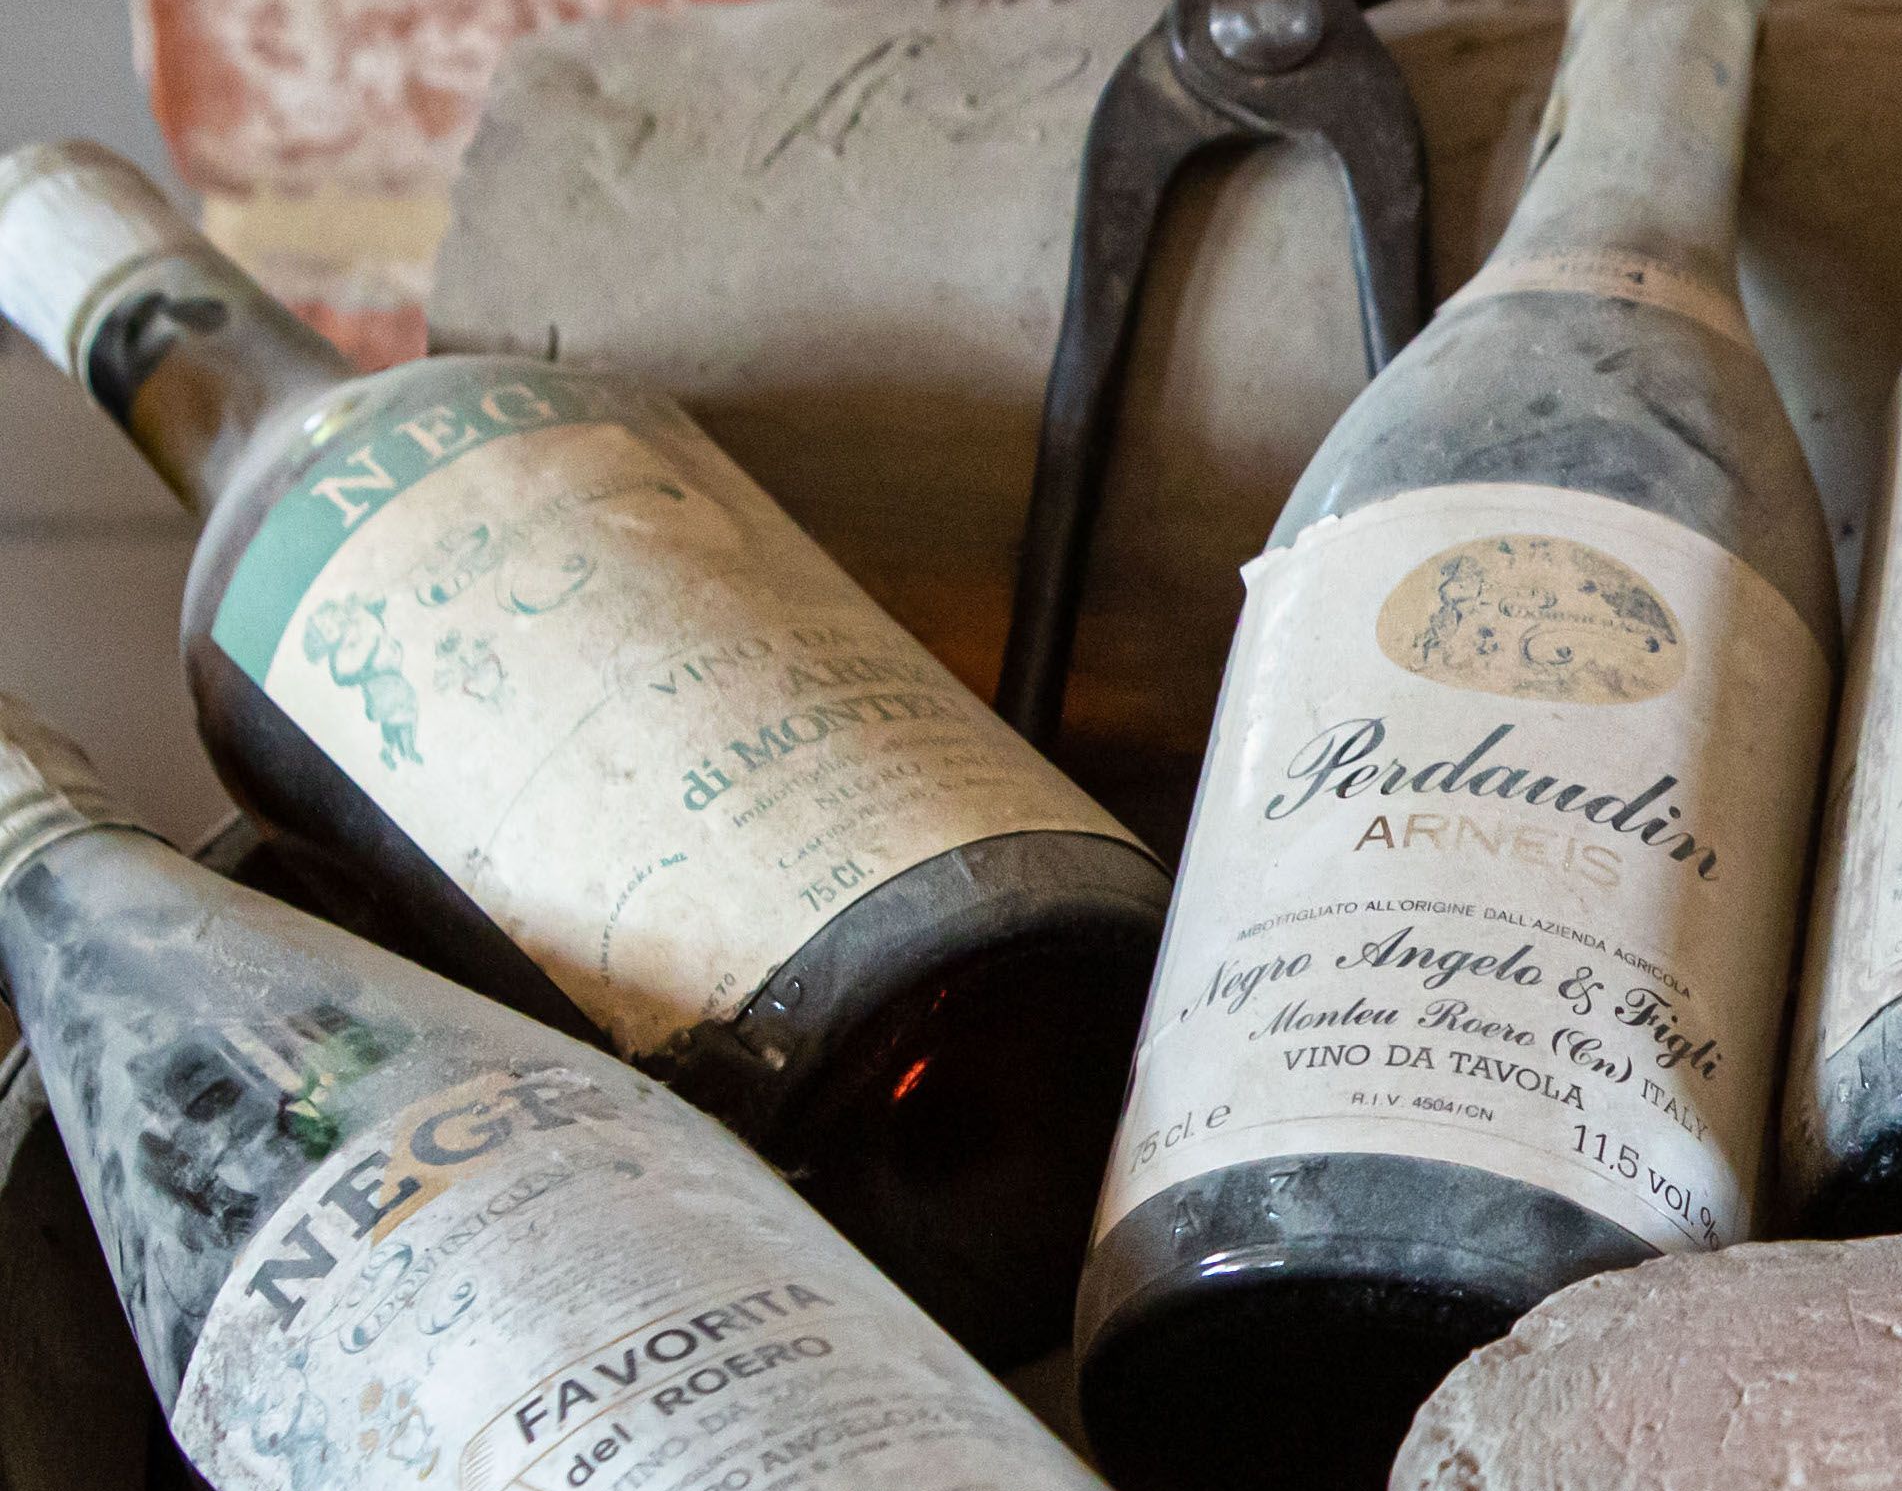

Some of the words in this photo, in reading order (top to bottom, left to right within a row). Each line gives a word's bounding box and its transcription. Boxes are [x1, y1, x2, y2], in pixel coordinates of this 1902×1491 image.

[648, 634, 773, 697] VINO
[681, 756, 734, 811] di
[1264, 715, 1719, 882] Perdaudin
[1353, 812, 1626, 891] ARNEIS
[799, 881, 837, 912] 75
[1236, 901, 1358, 942] IMBOTTIGLIATO
[1365, 898, 1475, 918] ALL'ORIGINE
[1483, 906, 1607, 953] DALL'AZIENDA
[1613, 946, 1692, 1000] AGRICOLA
[1180, 952, 1312, 1023] Negro
[1335, 925, 1545, 990] Angelo
[1557, 965, 1606, 1016] &
[1614, 986, 1723, 1082] Figli
[1248, 996, 1400, 1042] Monteu
[1416, 997, 1538, 1047] Roero
[1550, 1026, 1634, 1085] (Cn)
[1640, 1077, 1711, 1144] ITALY
[1283, 1043, 1371, 1072] VINO
[1385, 1043, 1435, 1070] DA
[1449, 1049, 1585, 1112] TAVOLA
[1205, 1104, 1232, 1130] e
[1411, 1095, 1495, 1122] 4504/CN
[1571, 1122, 1641, 1180] 11.5
[513, 1283, 836, 1445] FAVORITA
[566, 1422, 633, 1488] del
[650, 1335, 833, 1416] ROERO
